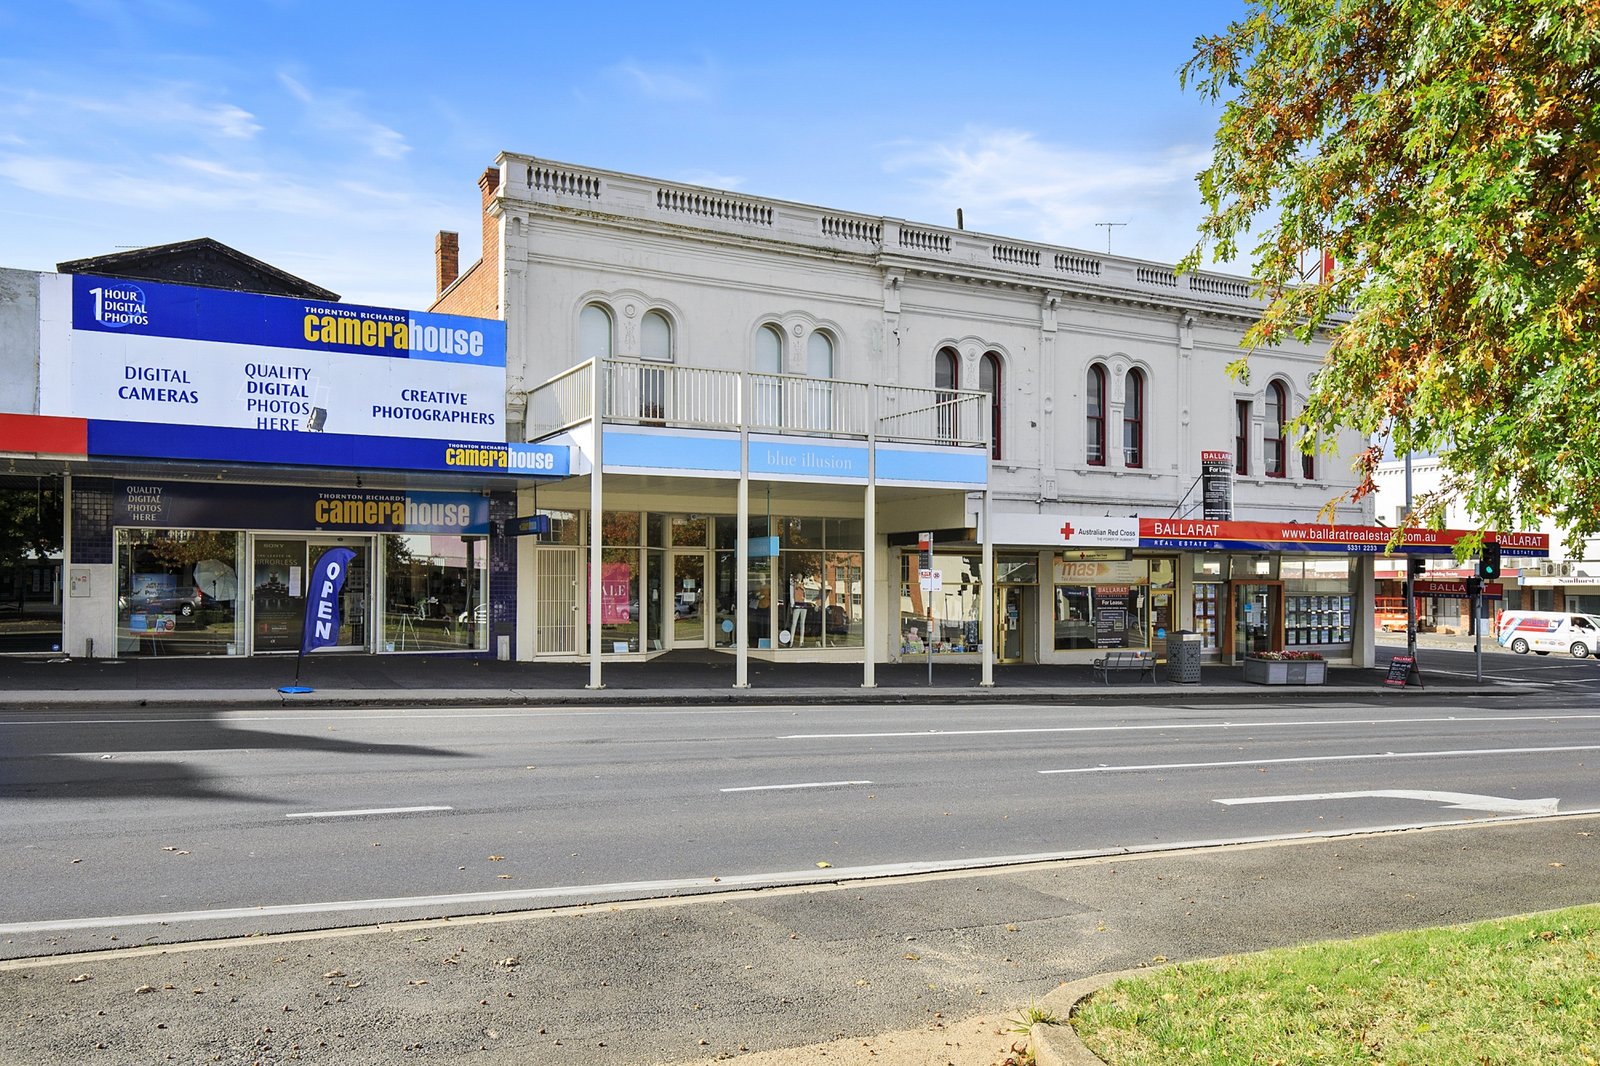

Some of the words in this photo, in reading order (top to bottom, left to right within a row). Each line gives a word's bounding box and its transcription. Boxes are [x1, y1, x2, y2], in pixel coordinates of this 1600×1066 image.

[89, 287, 103, 321] 1
[104, 289, 137, 301] HOUR
[104, 301, 148, 314] DIGITAL
[104, 312, 149, 325] PHOTOS
[304, 306, 357, 318] THORNTON
[361, 312, 406, 323] RICHARDS
[125, 366, 191, 384] DIGITAL
[244, 363, 312, 380] QUALITY
[118, 386, 199, 404] CAMERAS
[247, 381, 309, 398] DIGITAL
[401, 389, 468, 405] CREATIVE
[247, 399, 310, 415] PHOTOS
[372, 405, 495, 425] PHOTOGRAPHERS
[256, 417, 299, 431] HERE
[767, 449, 797, 466] blue
[801, 452, 852, 470] illusion
[126, 486, 163, 494] QUALITY
[128, 495, 161, 503] DIGITAL
[127, 504, 162, 512] PHOTOS
[132, 513, 157, 521] HERE
[1078, 528, 1107, 536] Australian
[1107, 529, 1119, 537] Red
[1154, 522, 1220, 537] BALLARAT
[1495, 535, 1543, 547] BALLARAT
[1062, 562, 1095, 577] mas
[600, 585, 626, 596] ALE
[1429, 583, 1488, 593] BALLAT
[315, 562, 341, 640] OPEN
